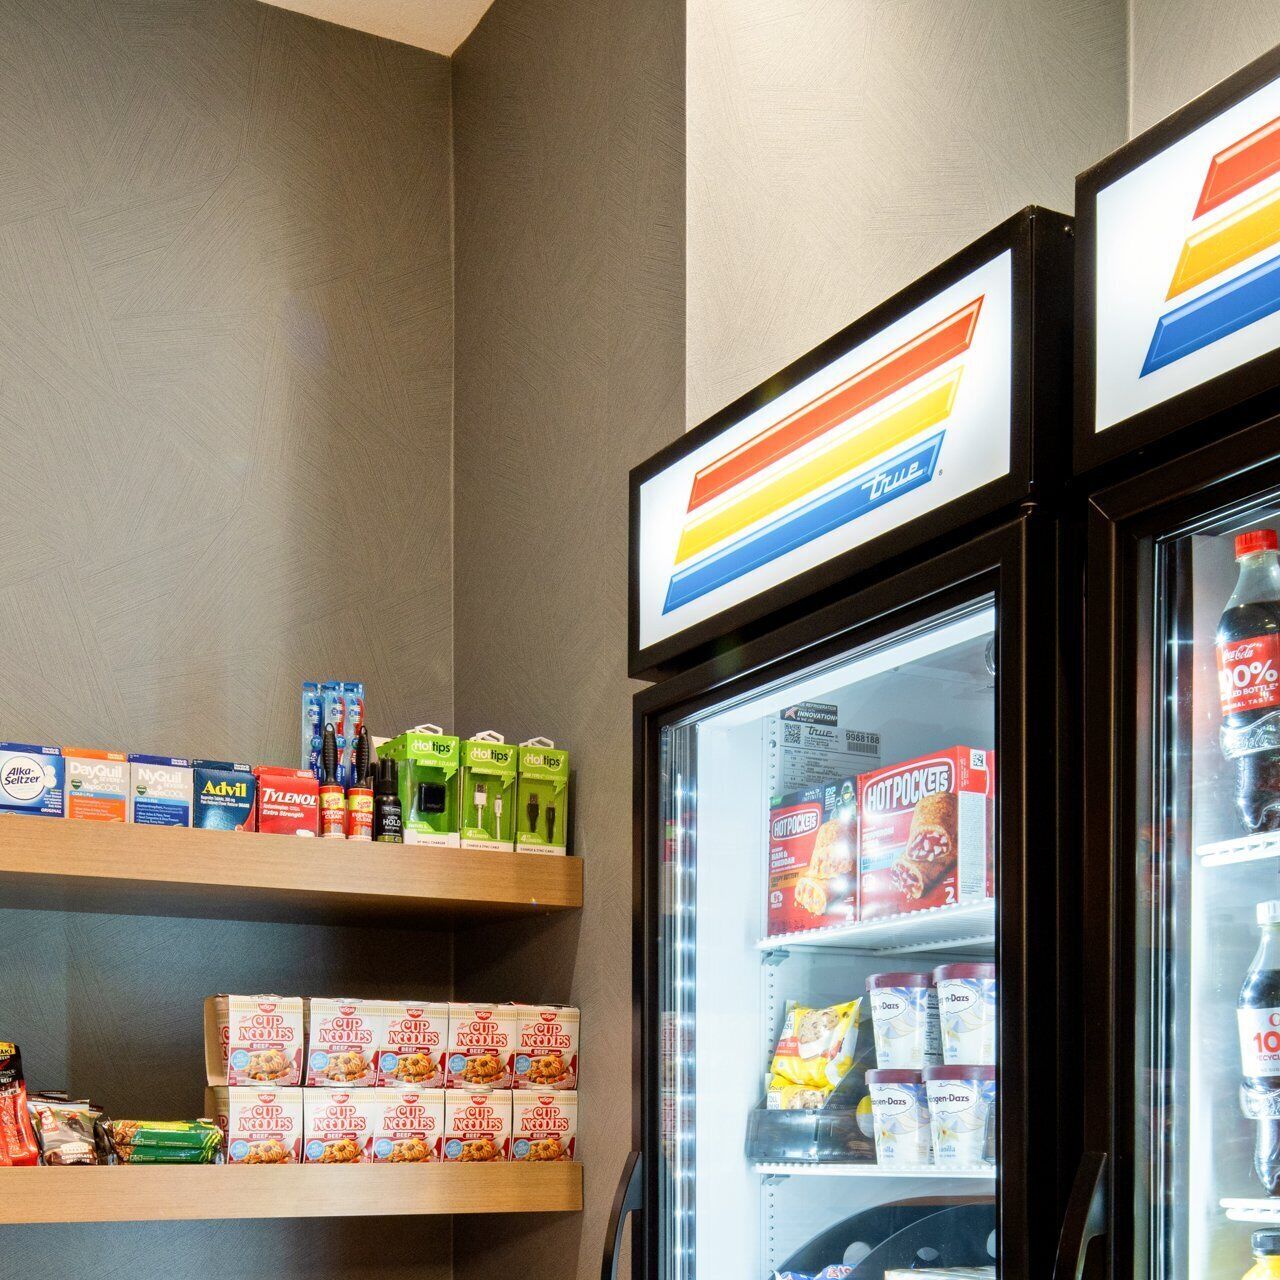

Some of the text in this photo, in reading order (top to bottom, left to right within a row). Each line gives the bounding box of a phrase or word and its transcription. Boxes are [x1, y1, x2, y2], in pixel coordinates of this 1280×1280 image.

[861, 461, 924, 500] true
[805, 725, 835, 739] true
[845, 732, 880, 745] 9988188
[414, 739, 452, 753] Hottips
[473, 747, 510, 762] Hottips
[526, 755, 561, 768] Hottips
[7, 767, 35, 777] Alka-
[70, 762, 123, 778] DayQuil
[138, 769, 182, 784] NyQuil
[4, 775, 41, 786] Seltzer
[202, 780, 247, 797] Advil
[867, 766, 950, 811] HOT POCKETS
[262, 788, 317, 806] TYLENOL
[279, 810, 304, 818] Strength
[383, 818, 401, 827] HOLD
[773, 812, 817, 836] HOT POCKETS
[945, 887, 954, 904] 2
[252, 1015, 283, 1028] CUP
[331, 1017, 363, 1031] CUP
[401, 1020, 430, 1033] CUP
[469, 1022, 498, 1035] CUP
[239, 1027, 294, 1041] NOODLES
[319, 1029, 372, 1043] NOODLES
[534, 1023, 562, 1037] CUP
[388, 1031, 440, 1045] NOODLES
[456, 1033, 508, 1047] NOODLES
[521, 1034, 571, 1048] NOODLES
[251, 1105, 283, 1119] CUP
[238, 1117, 293, 1131] NOODLES
[313, 1117, 366, 1131] NOODLES
